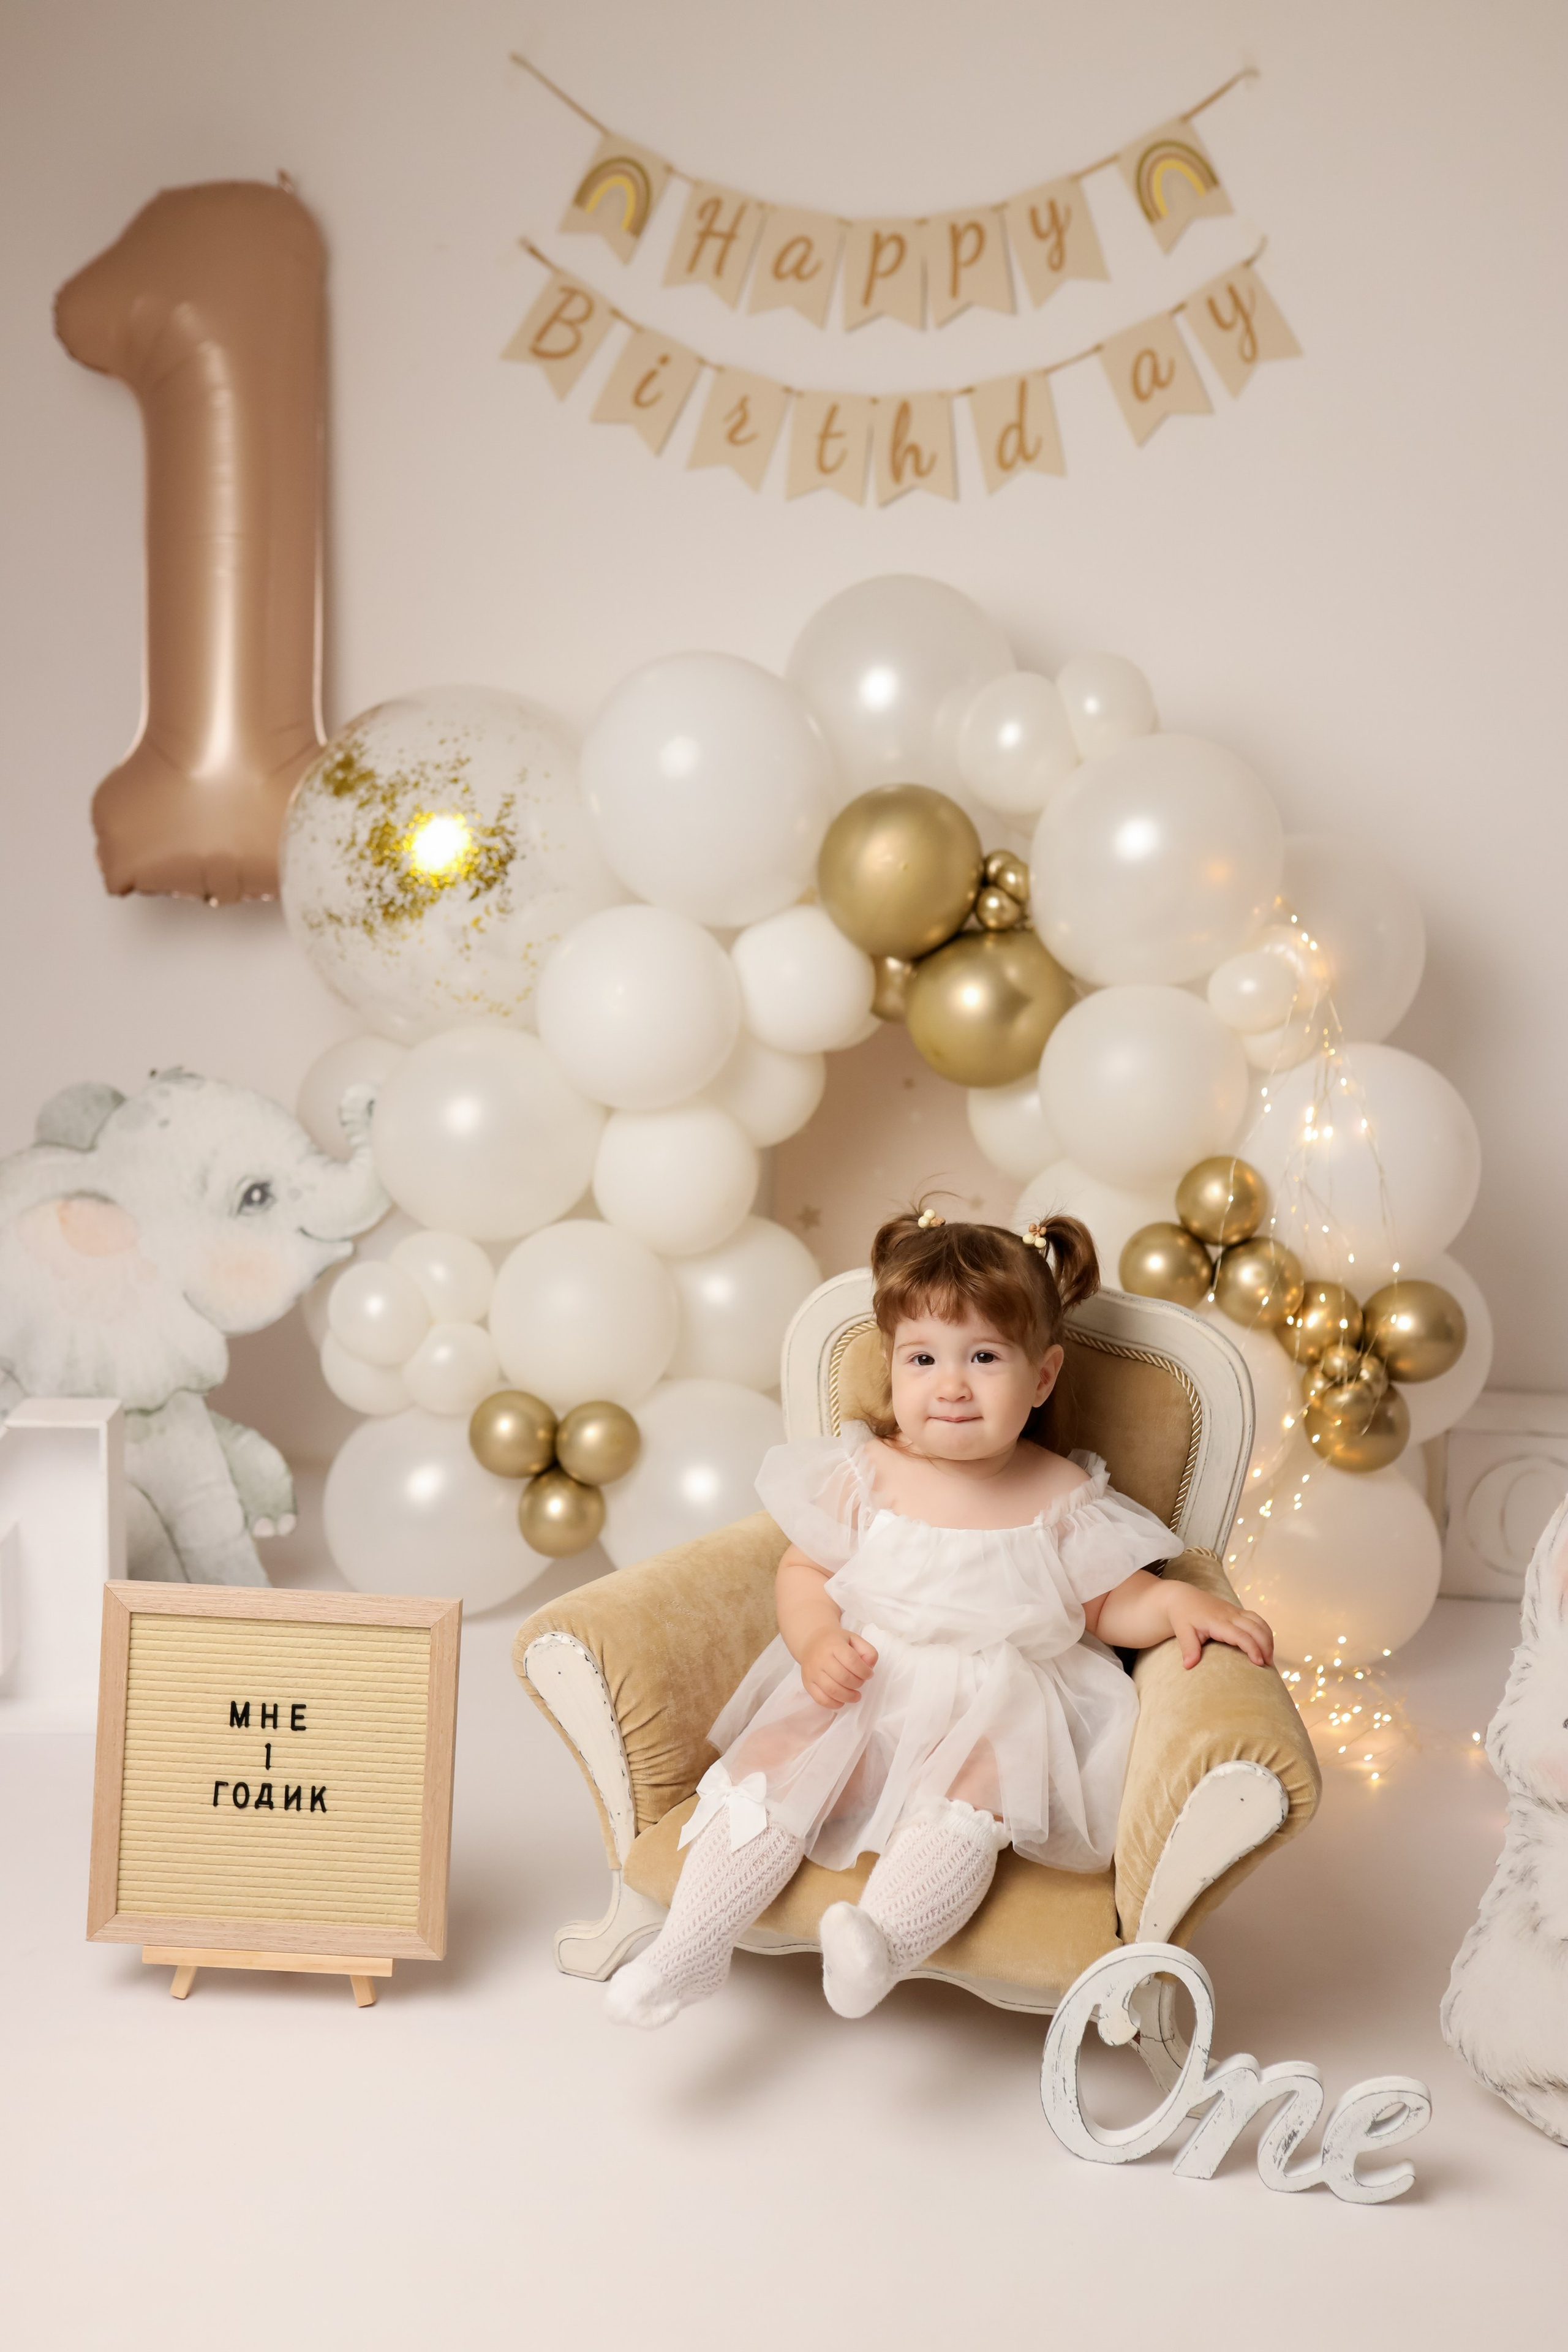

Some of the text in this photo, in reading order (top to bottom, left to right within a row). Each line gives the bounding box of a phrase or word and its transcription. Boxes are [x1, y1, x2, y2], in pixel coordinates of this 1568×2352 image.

[687, 196, 1072, 307] Happy
[529, 282, 1259, 484] Birthday
[53, 178, 328, 904] 1
[230, 1701, 307, 1731] МНЕ
[265, 1743, 272, 1770] 1
[213, 1781, 327, 1812] ГОДИК
[1039, 1942, 1432, 2205] One
